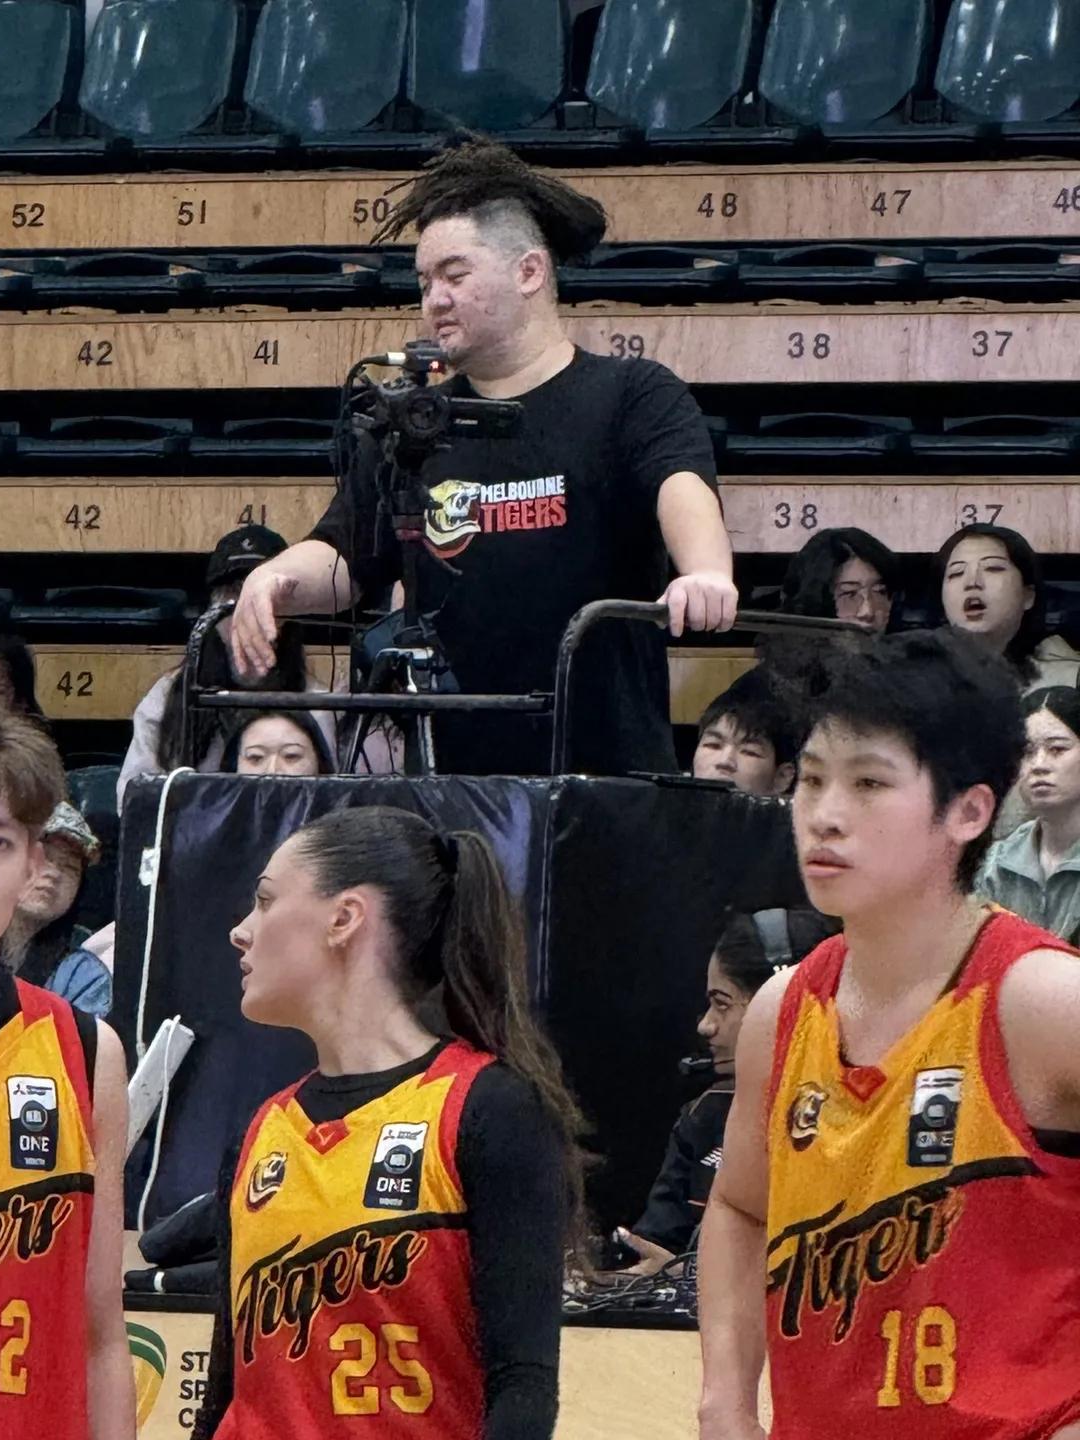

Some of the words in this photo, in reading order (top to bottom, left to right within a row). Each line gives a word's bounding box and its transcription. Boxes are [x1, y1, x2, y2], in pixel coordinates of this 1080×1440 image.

[12, 202, 45, 229] 52
[177, 199, 207, 227] 51
[353, 198, 389, 223] 50
[697, 192, 738, 218] 48
[870, 189, 912, 217] 47
[77, 340, 113, 367] 42
[253, 339, 279, 365] 41
[609, 334, 646, 360] 39
[787, 331, 831, 360] 38
[972, 330, 1013, 358] 37
[480, 475, 565, 503] MELBOURNE
[64, 504, 101, 530] 42
[480, 496, 567, 533] TIGERS
[774, 502, 818, 530] 38
[961, 503, 1004, 528] 37
[56, 670, 94, 697] 42
[20, 1135, 50, 1152] ONE
[376, 1177, 413, 1193] ONE
[237, 1232, 427, 1366] Tigers
[329, 1323, 434, 1415] 25
[877, 1306, 957, 1407] 18
